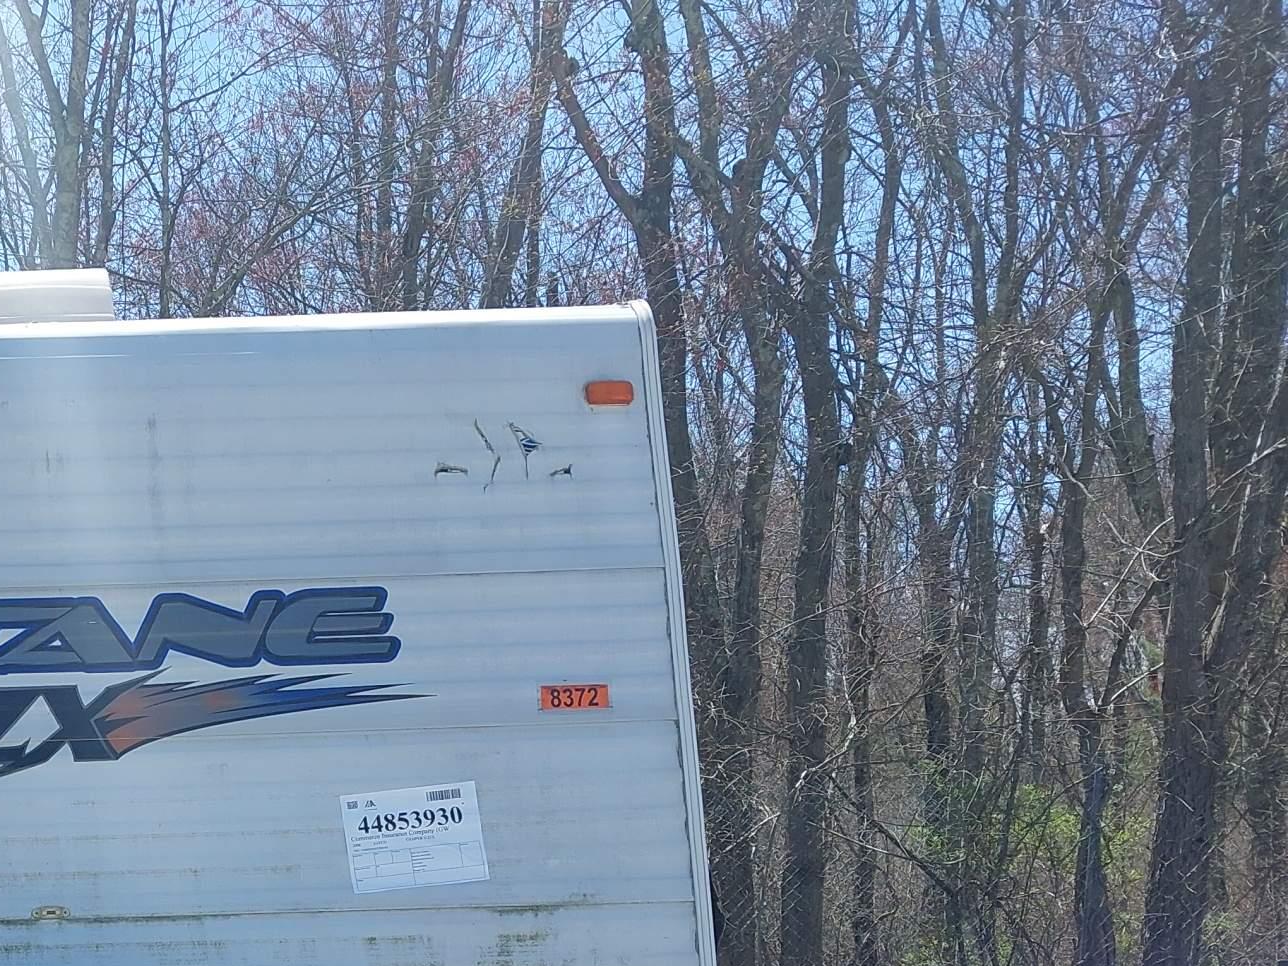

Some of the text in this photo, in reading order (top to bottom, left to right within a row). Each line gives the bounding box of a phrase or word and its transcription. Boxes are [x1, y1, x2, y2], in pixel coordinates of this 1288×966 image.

[550, 687, 599, 708] 8372
[357, 806, 463, 834] 44853930
[408, 828, 434, 837] Company
